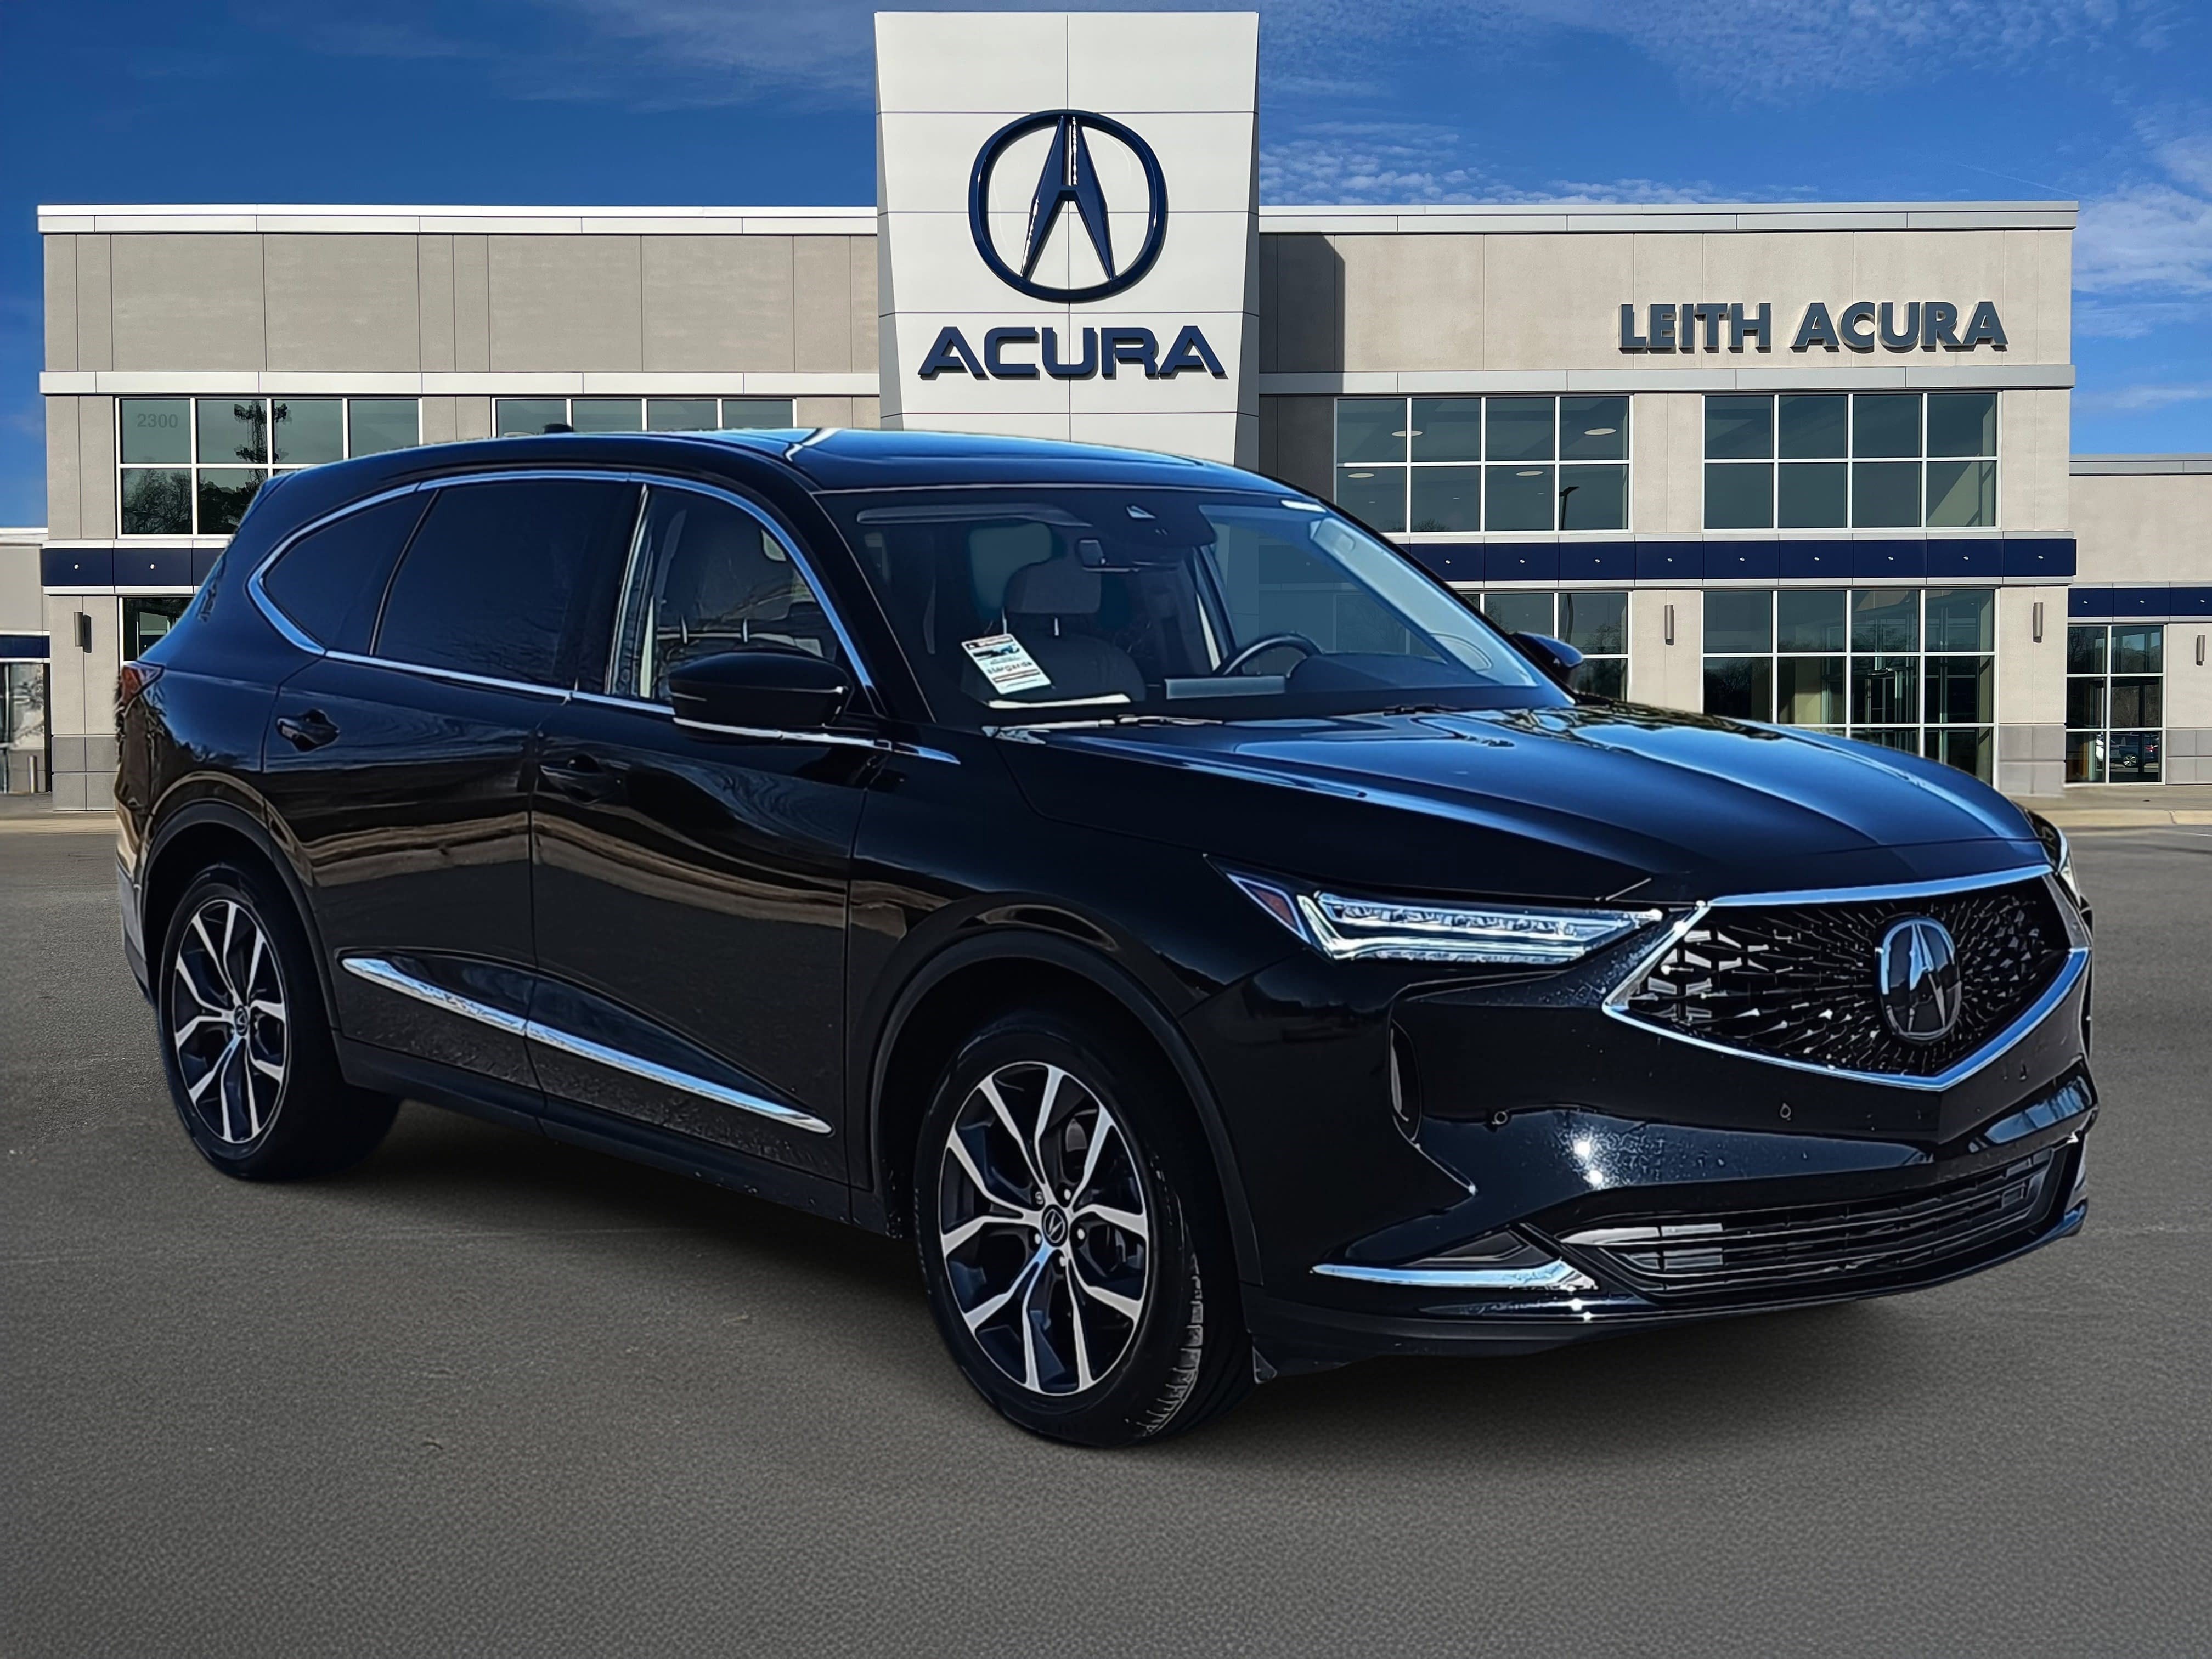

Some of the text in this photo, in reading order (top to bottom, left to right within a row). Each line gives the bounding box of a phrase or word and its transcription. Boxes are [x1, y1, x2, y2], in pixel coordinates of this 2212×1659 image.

[918, 325, 1227, 379] ACURA
[1620, 301, 2008, 353] LEITH ACURA
[137, 413, 178, 428] 2300
